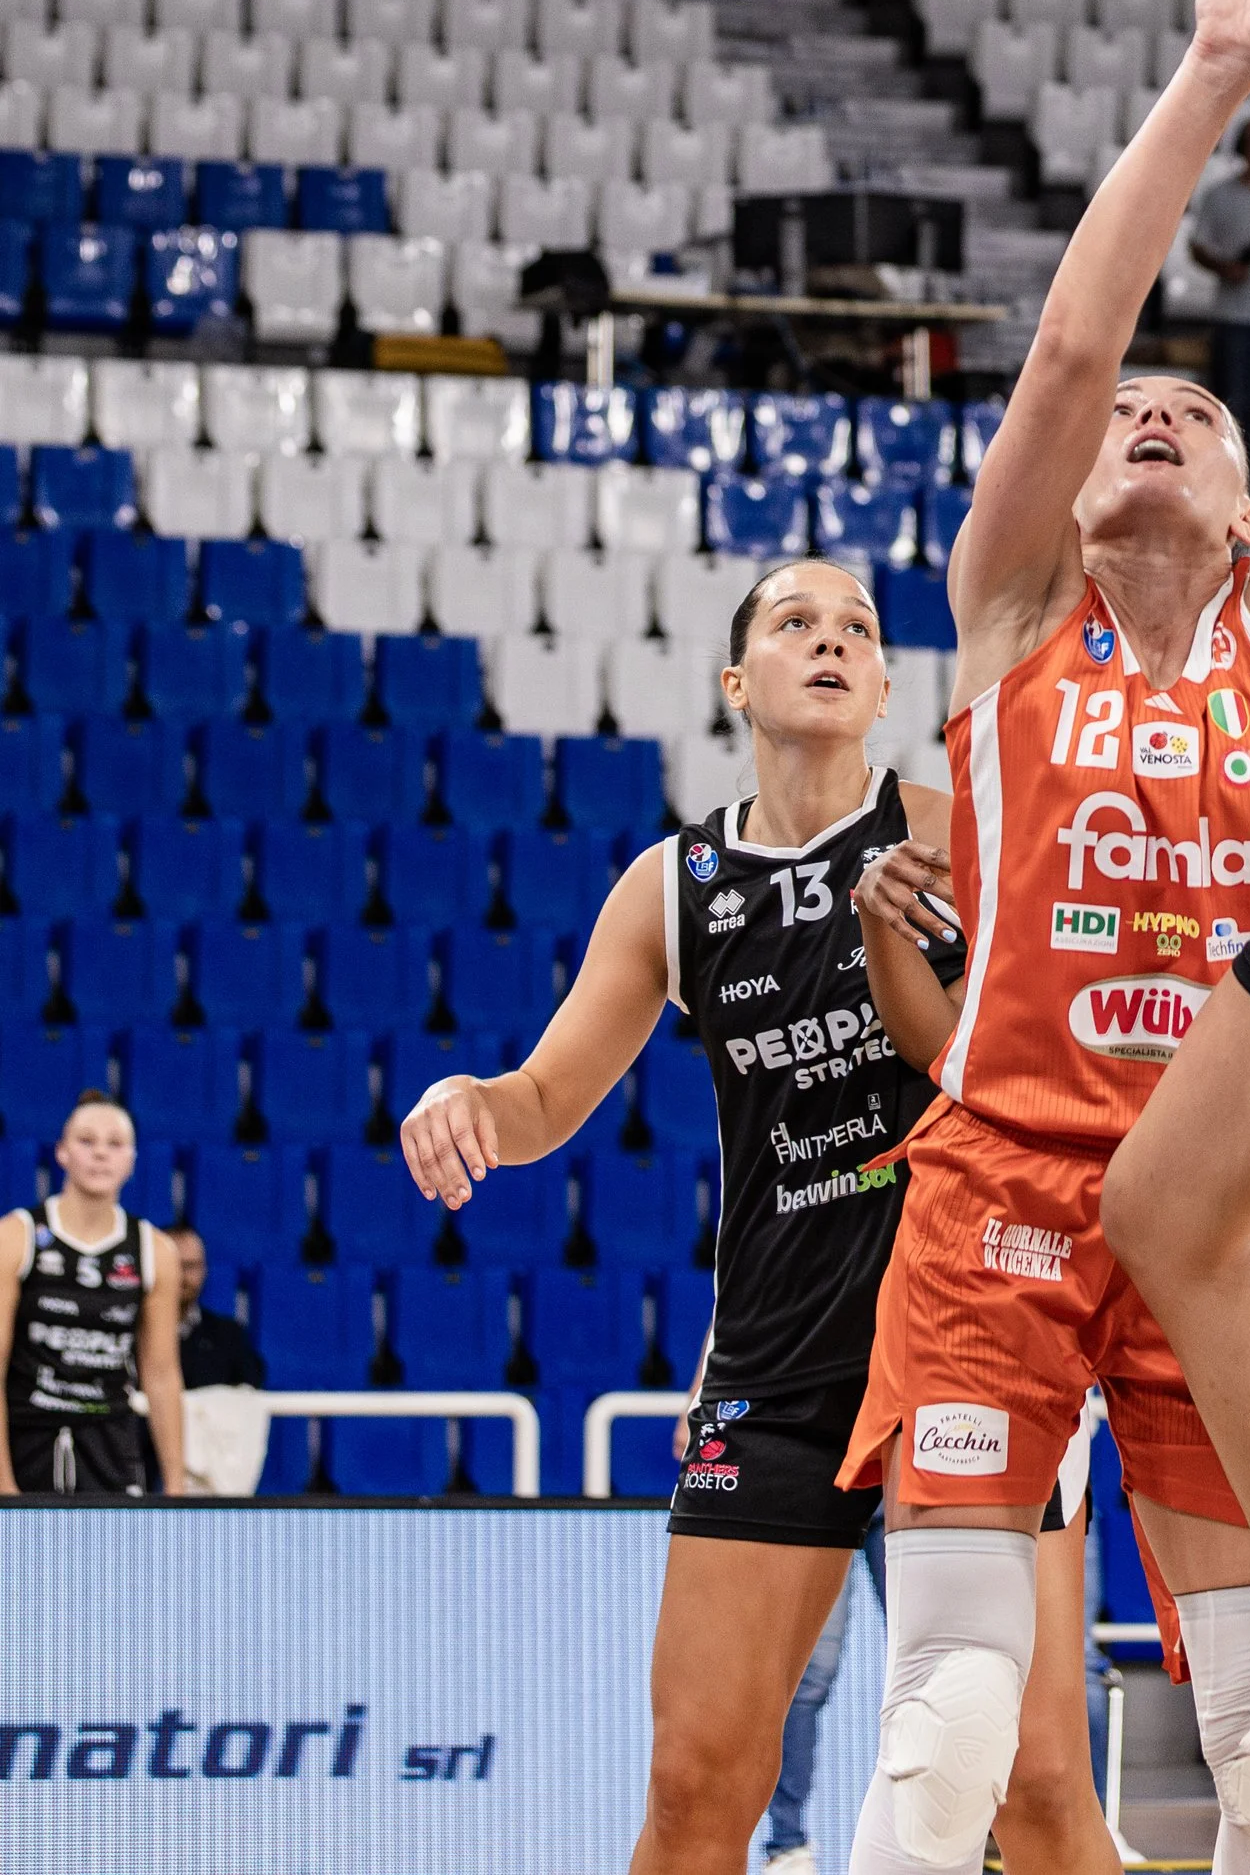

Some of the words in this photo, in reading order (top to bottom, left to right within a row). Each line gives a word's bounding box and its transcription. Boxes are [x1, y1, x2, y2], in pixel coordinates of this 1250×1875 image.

[1051, 678, 1125, 770] 12
[1140, 754, 1192, 765] VENOSTA
[770, 860, 833, 927] 13
[1055, 909, 1117, 937] HDI
[1133, 911, 1200, 939] HYPNO
[719, 974, 781, 1003] HOYA
[1109, 1046, 1168, 1058] SPECIALISTA
[982, 1217, 1003, 1246] IL
[999, 1248, 1063, 1282] VICENZA
[940, 1412, 983, 1427] FRATELLI
[919, 1426, 1001, 1452] Cecchin
[400, 1733, 496, 1781] srl
